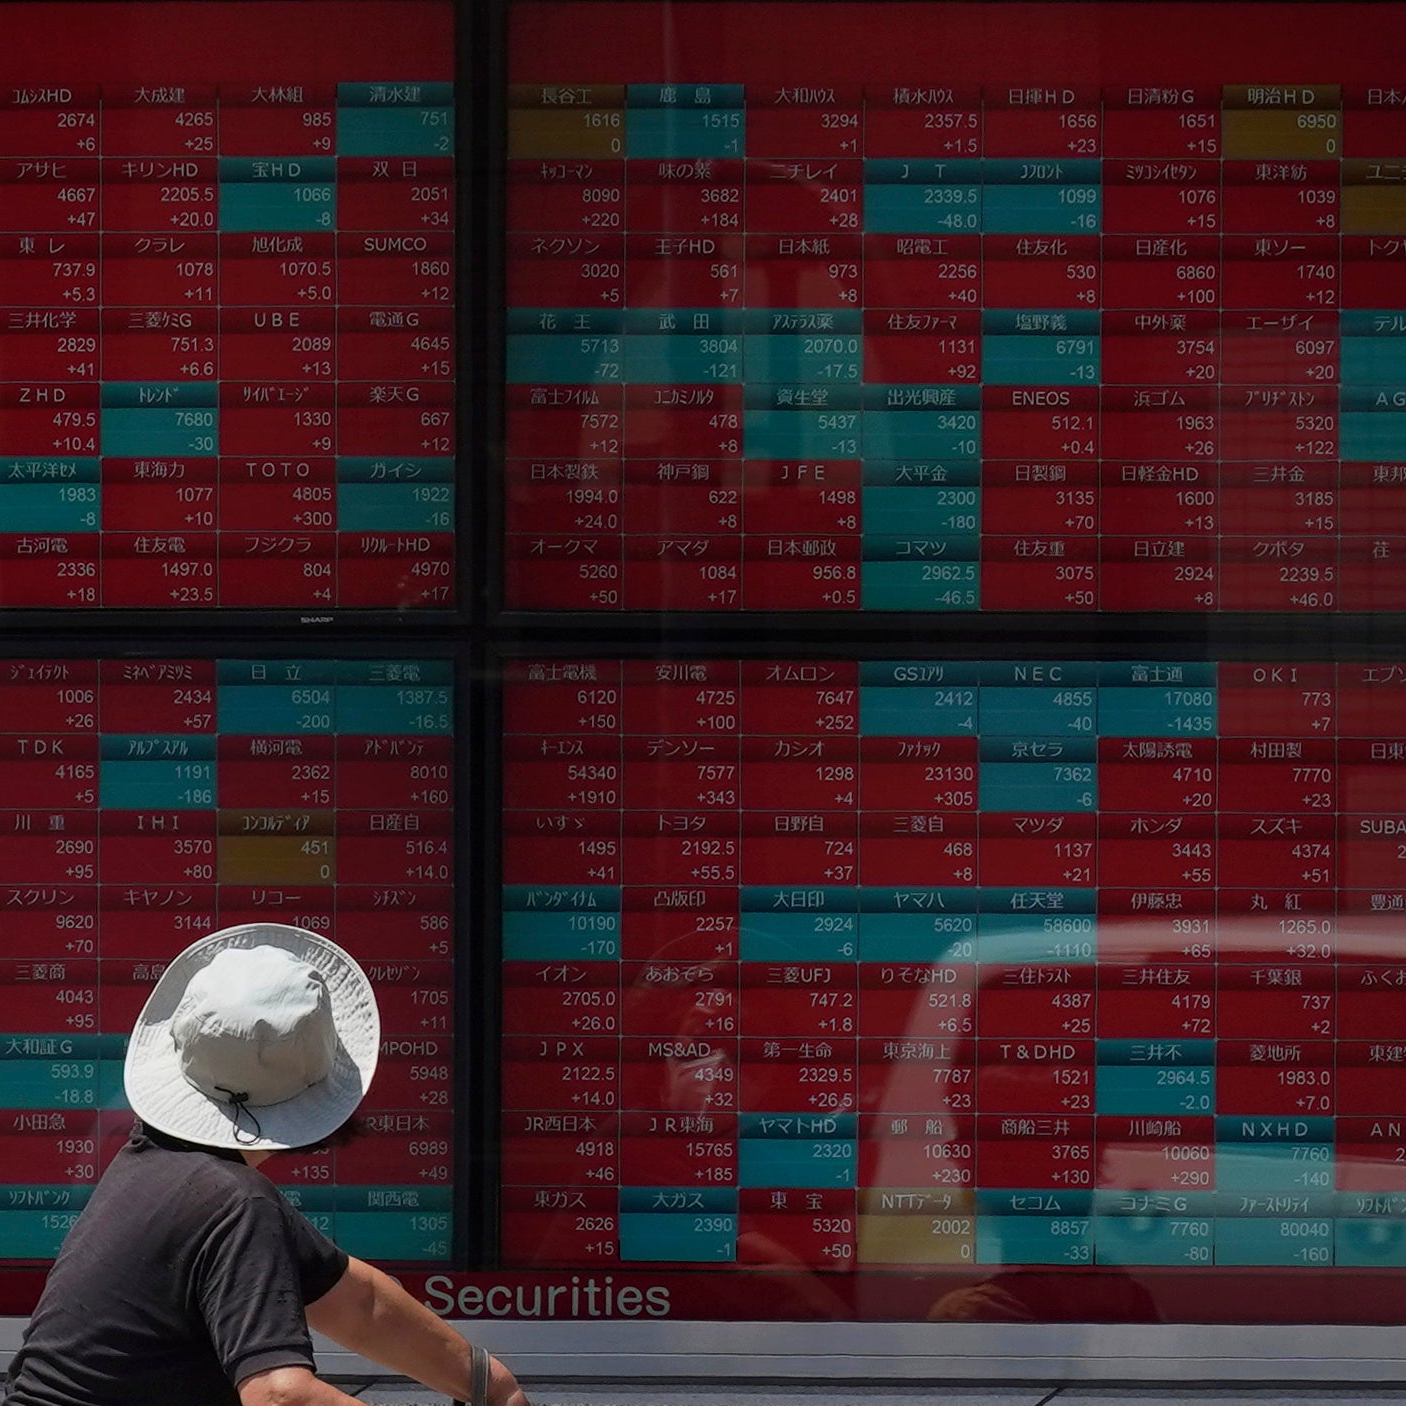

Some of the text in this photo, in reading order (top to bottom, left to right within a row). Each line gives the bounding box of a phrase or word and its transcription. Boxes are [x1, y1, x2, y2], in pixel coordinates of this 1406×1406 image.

[134, 86, 185, 104] 大成建
[174, 111, 214, 127] 4265
[184, 136, 214, 151] +25
[1255, 163, 1307, 181] 東洋紡
[1298, 189, 1336, 204] 1039
[1315, 213, 1336, 229] +8
[251, 236, 303, 253] 旭化成
[364, 237, 427, 252] SUMCO
[656, 238, 716, 255] 王子HD
[1016, 238, 1068, 256] 住友化
[1136, 238, 1188, 256] 日産化
[279, 261, 332, 276] 1070.5
[412, 260, 450, 276] 1860
[710, 263, 737, 279] 561
[1066, 264, 1096, 280] 530
[1176, 265, 1216, 280] 6860
[297, 285, 332, 301] +5.0
[421, 286, 450, 301] +12
[719, 287, 740, 303] +7
[1076, 289, 1096, 304] +8
[1176, 288, 1216, 304] +100
[9, 311, 76, 329] 三井化学
[1015, 313, 1067, 331] 塩野義
[57, 337, 96, 353] 2829
[1056, 339, 1094, 355] 6791
[66, 362, 94, 377] +41
[1069, 364, 1096, 380] -13
[1012, 390, 1070, 406] ENEOS
[1133, 390, 1186, 407] 浜ゴム
[1051, 415, 1093, 431] 512.1
[1176, 415, 1215, 431] 1963
[1061, 440, 1095, 455] +0.4
[1184, 440, 1215, 456] +26
[133, 461, 185, 479] 東海力
[531, 463, 599, 481] 日本製鉄
[1122, 465, 1199, 482] 日軽金HD
[175, 487, 214, 503] 1077
[566, 488, 619, 504] 1994.0
[1176, 490, 1215, 506] 1600
[184, 511, 213, 526] +10
[574, 513, 618, 529] +24.0
[1184, 514, 1215, 531] +13
[133, 536, 186, 554] 住友電
[768, 539, 836, 557] 日本郵政
[1134, 540, 1185, 558] 日立建
[161, 561, 213, 577] 1497.0
[812, 565, 857, 580] 956.8
[1174, 566, 1215, 582] 2924
[169, 586, 213, 602] +23.5
[822, 589, 856, 604] +0.5
[1194, 591, 1214, 606] +8
[766, 664, 835, 682] オムロン
[816, 690, 855, 705] 7647
[815, 714, 854, 730] +252
[647, 739, 715, 756] デンソー
[1122, 741, 1193, 759] 太陽誘電
[697, 765, 735, 781] 7577
[1172, 767, 1212, 783] 4710
[697, 789, 736, 805] +343
[1182, 792, 1212, 807] +20
[370, 814, 419, 831] 日産自
[659, 815, 706, 831] トヨタ
[1130, 816, 1183, 834] ホンダ
[405, 839, 448, 855] 516.4
[681, 840, 735, 856] 2192.5
[1172, 842, 1212, 858] 3443
[405, 864, 449, 880] +14.0
[690, 865, 735, 881] +55.5
[1181, 867, 1212, 883] +55
[773, 890, 825, 908] 大日印
[813, 916, 854, 932] 2924
[837, 941, 854, 957] -6
[768, 966, 831, 984] 三菱UFJ
[809, 992, 853, 1008] 747.2
[818, 1016, 853, 1032] +1.8
[1130, 1043, 1183, 1061] 三井不
[1156, 1070, 1211, 1086] 2964.5
[1179, 1094, 1210, 1110] -2.0
[13, 1113, 66, 1131] 小田急
[524, 1115, 597, 1132] JR西日本
[759, 1117, 837, 1134] ヤマトHD
[56, 1139, 95, 1155] 1930
[575, 1141, 615, 1157] 4918
[812, 1143, 852, 1159] 2320
[65, 1163, 95, 1179] +30
[585, 1166, 615, 1181] +46
[834, 1168, 850, 1183] -1
[652, 1191, 705, 1209] 大ガス
[694, 1217, 733, 1233] 2390
[716, 1242, 731, 1257] -1
[424, 1275, 671, 1317] Securities
